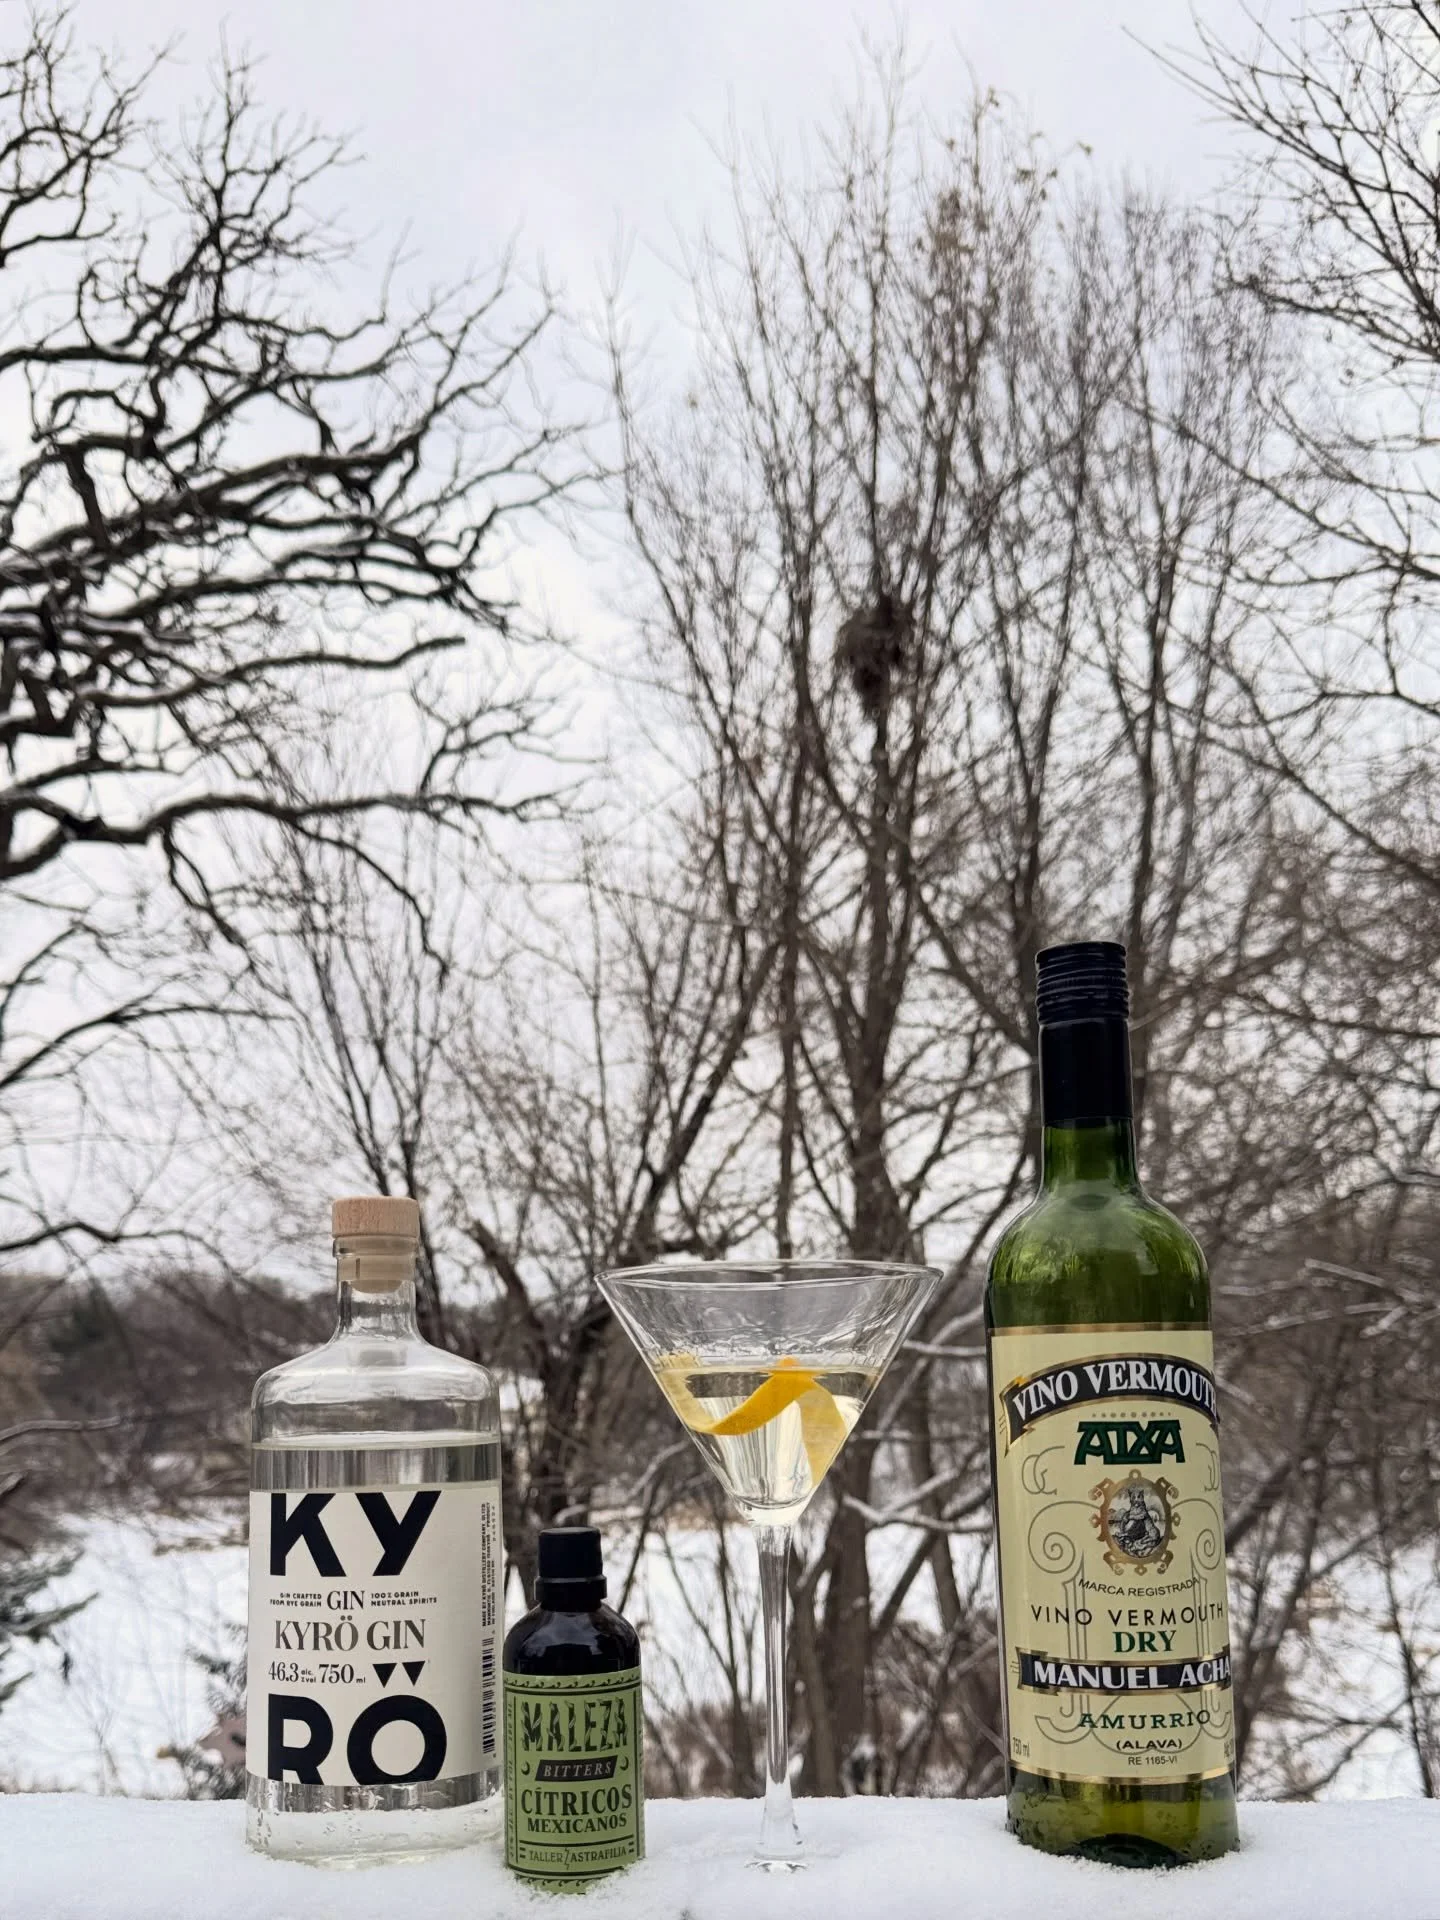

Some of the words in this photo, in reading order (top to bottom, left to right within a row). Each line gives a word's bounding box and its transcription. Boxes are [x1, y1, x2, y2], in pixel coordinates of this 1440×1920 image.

[1012, 1370, 1078, 1421] VINO
[270, 1490, 442, 1577] KY
[1079, 1578, 1125, 1596] MARCA
[1128, 1577, 1200, 1597] REGISTRADA
[327, 1590, 365, 1611] GIN
[409, 1597, 437, 1605] SPIRITS
[1031, 1604, 1092, 1625] VINO
[1108, 1602, 1224, 1626] VERMOUTH
[275, 1615, 359, 1651] KYRÖ
[366, 1619, 426, 1651] GIN
[1112, 1630, 1177, 1653] DRY
[268, 1661, 299, 1682] 46.3
[318, 1663, 354, 1684] 750
[1034, 1661, 1168, 1689] MANUEL
[1179, 1655, 1230, 1687] ACHA
[521, 1697, 628, 1752] MALEZA
[1078, 1710, 1210, 1729] AMURRIO
[1116, 1738, 1182, 1751] (ALAVA)
[543, 1760, 612, 1778] BITTERS
[1128, 1756, 1142, 1765] RE
[521, 1783, 632, 1816] CÍTRICOS
[527, 1812, 628, 1834] MEXICANOS
[529, 1850, 562, 1863] TALLER
[570, 1846, 627, 1863] ASTRAFILIA
